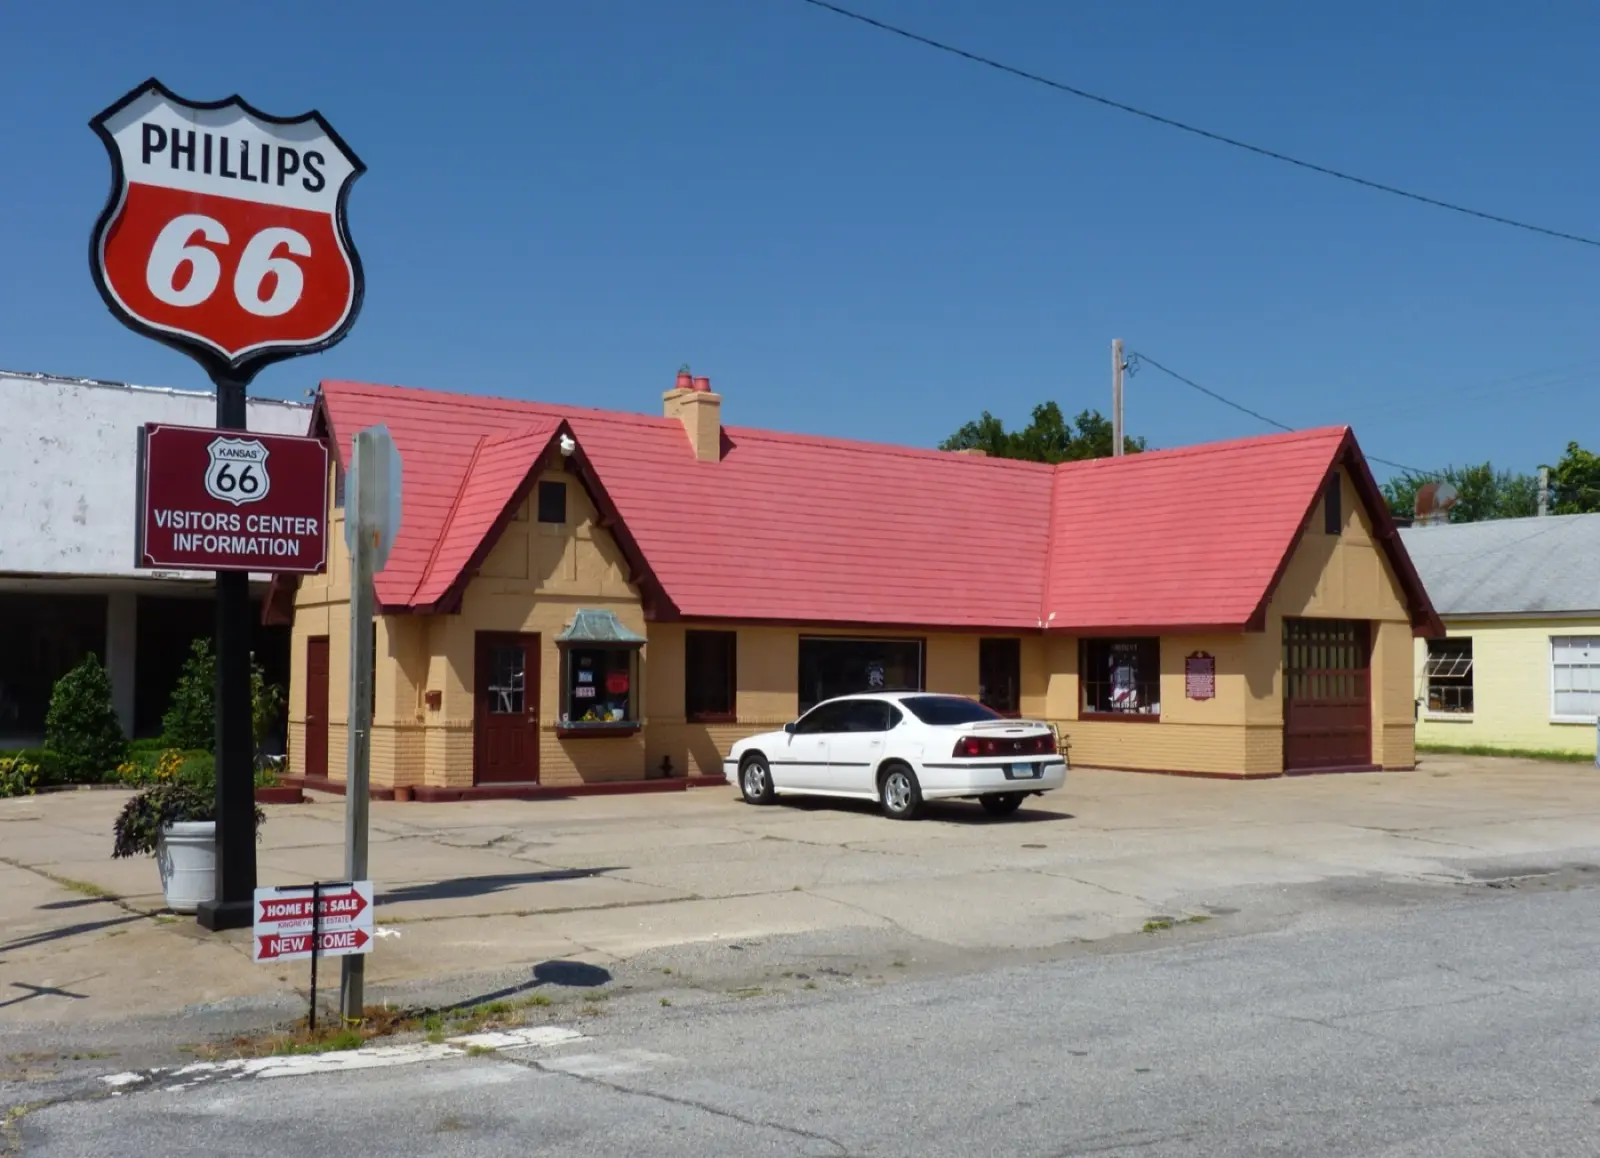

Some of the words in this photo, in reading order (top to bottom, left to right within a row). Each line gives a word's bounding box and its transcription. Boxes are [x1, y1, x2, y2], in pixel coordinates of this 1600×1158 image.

[142, 122, 326, 193] PHILLIPS
[146, 213, 312, 318] 66
[219, 448, 257, 459] KANSAS
[216, 463, 259, 494] 66
[153, 508, 241, 532] VISITORS
[246, 514, 318, 536] CENTER
[173, 533, 300, 557] INFORMATION
[267, 903, 302, 917] HOME
[330, 899, 358, 912] SALE
[326, 916, 350, 925] ESTATE
[270, 936, 306, 954] NEW
